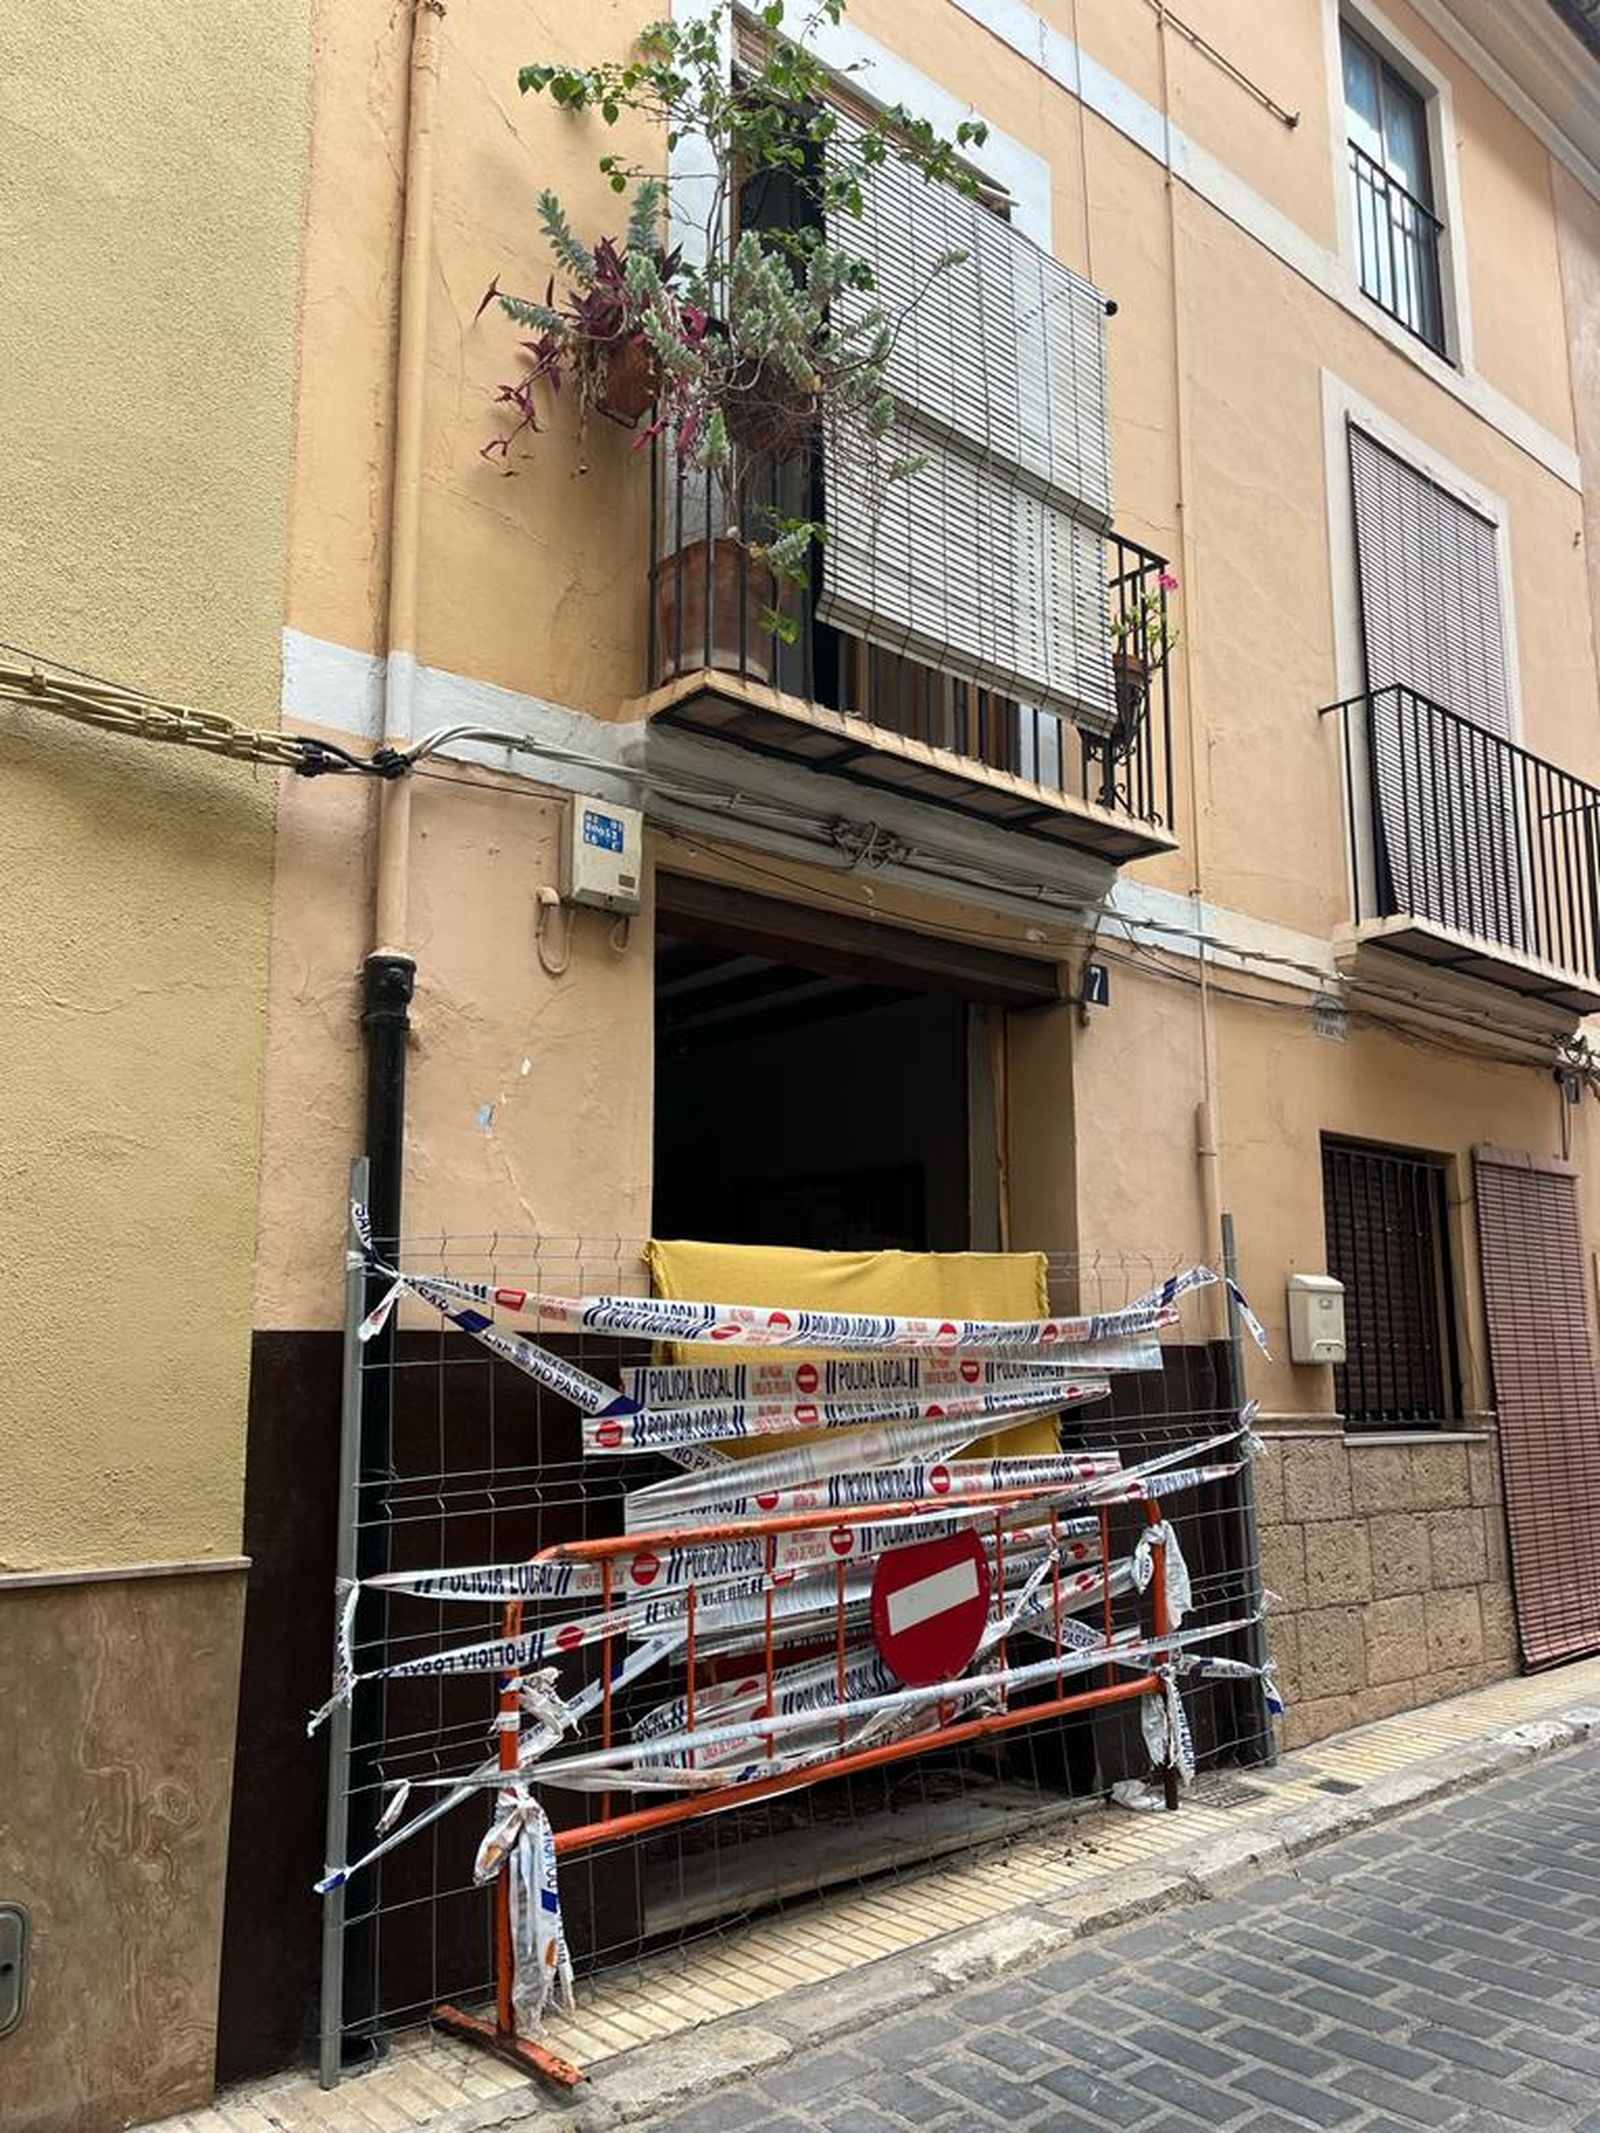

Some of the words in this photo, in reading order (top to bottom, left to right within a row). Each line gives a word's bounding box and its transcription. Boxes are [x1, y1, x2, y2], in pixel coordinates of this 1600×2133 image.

[1091, 966, 1101, 1000] 7
[530, 1360, 553, 1383] NO
[553, 1374, 600, 1414] PASAR
[649, 1369, 694, 1402] POLICIA
[696, 1367, 734, 1398] LOCAL
[839, 1361, 876, 1388] POLICIA
[876, 1359, 909, 1387] LOCAL
[684, 1544, 729, 1580] POLICIA
[730, 1538, 764, 1574] LOCAL
[439, 1567, 505, 1594] POLICIA
[508, 1563, 554, 1594] LOCAL
[460, 1640, 526, 1668] POLICIA
